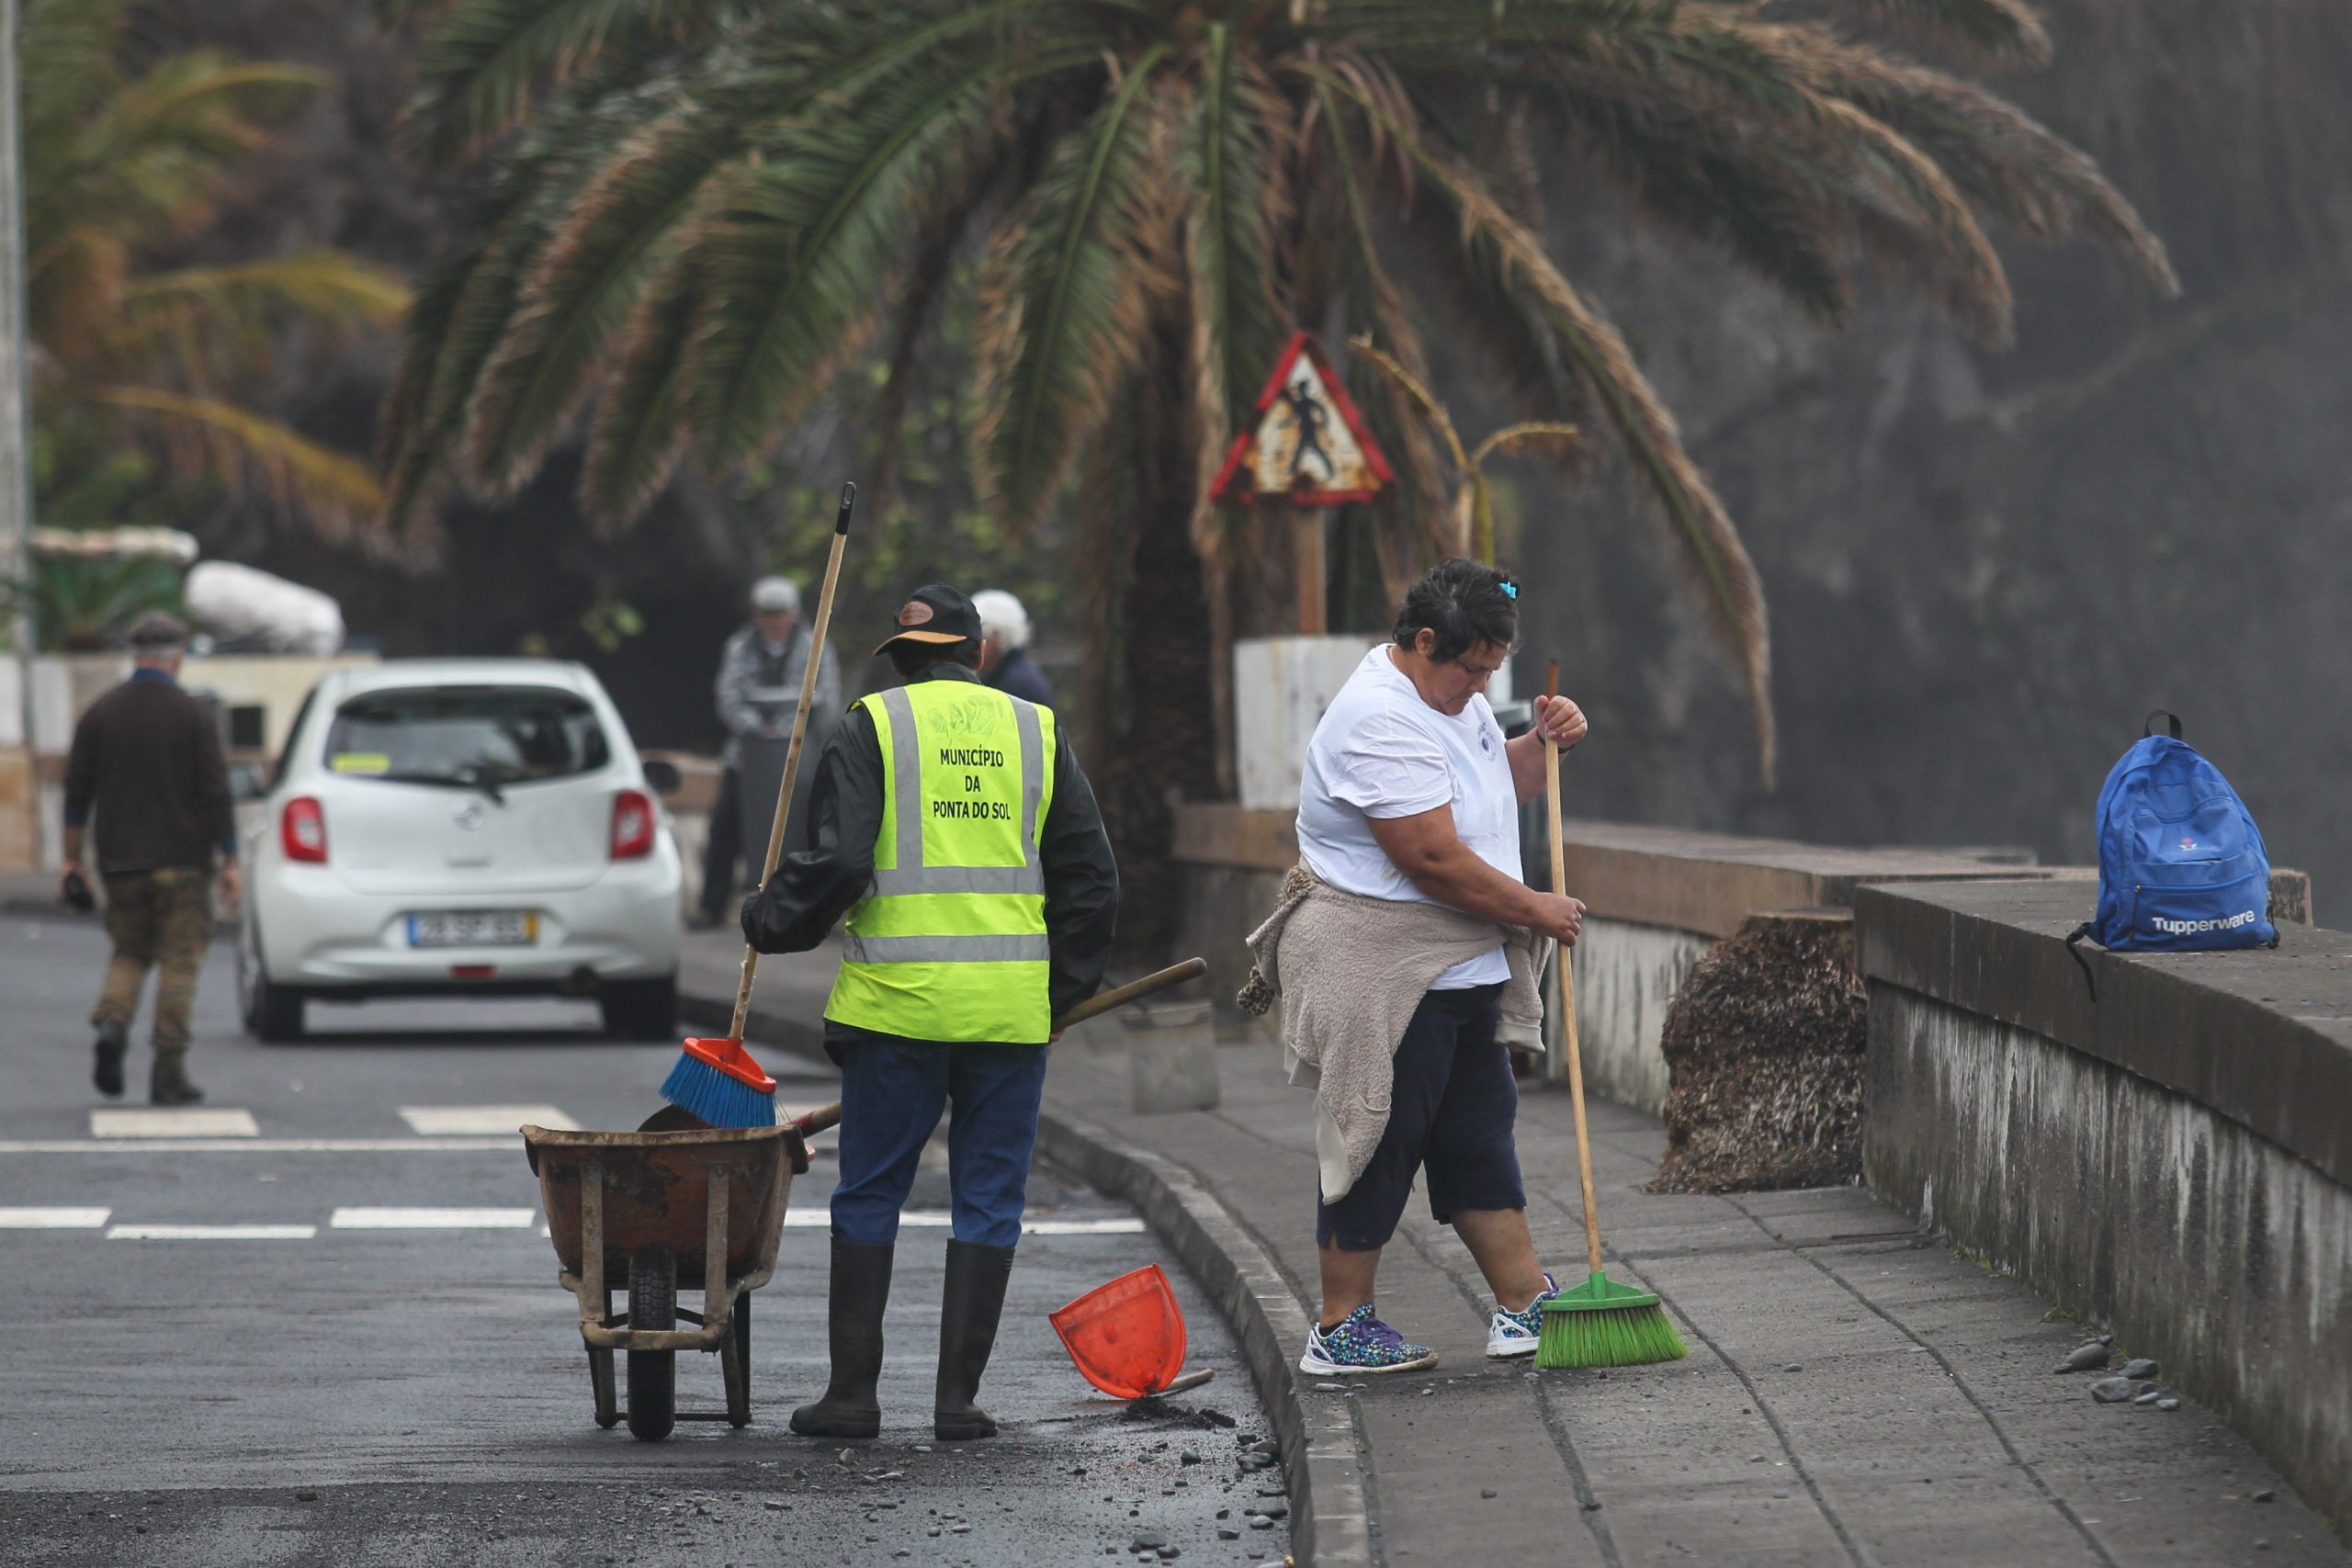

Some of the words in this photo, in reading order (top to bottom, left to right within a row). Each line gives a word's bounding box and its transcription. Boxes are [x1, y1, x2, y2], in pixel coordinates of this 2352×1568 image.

[940, 744, 1004, 767] MUNICÍPIO
[965, 775, 981, 793] DA
[933, 801, 969, 818] PONTA
[972, 802, 989, 819] DO
[991, 802, 1011, 820] SOL
[2151, 909, 2256, 936] Tupperware
